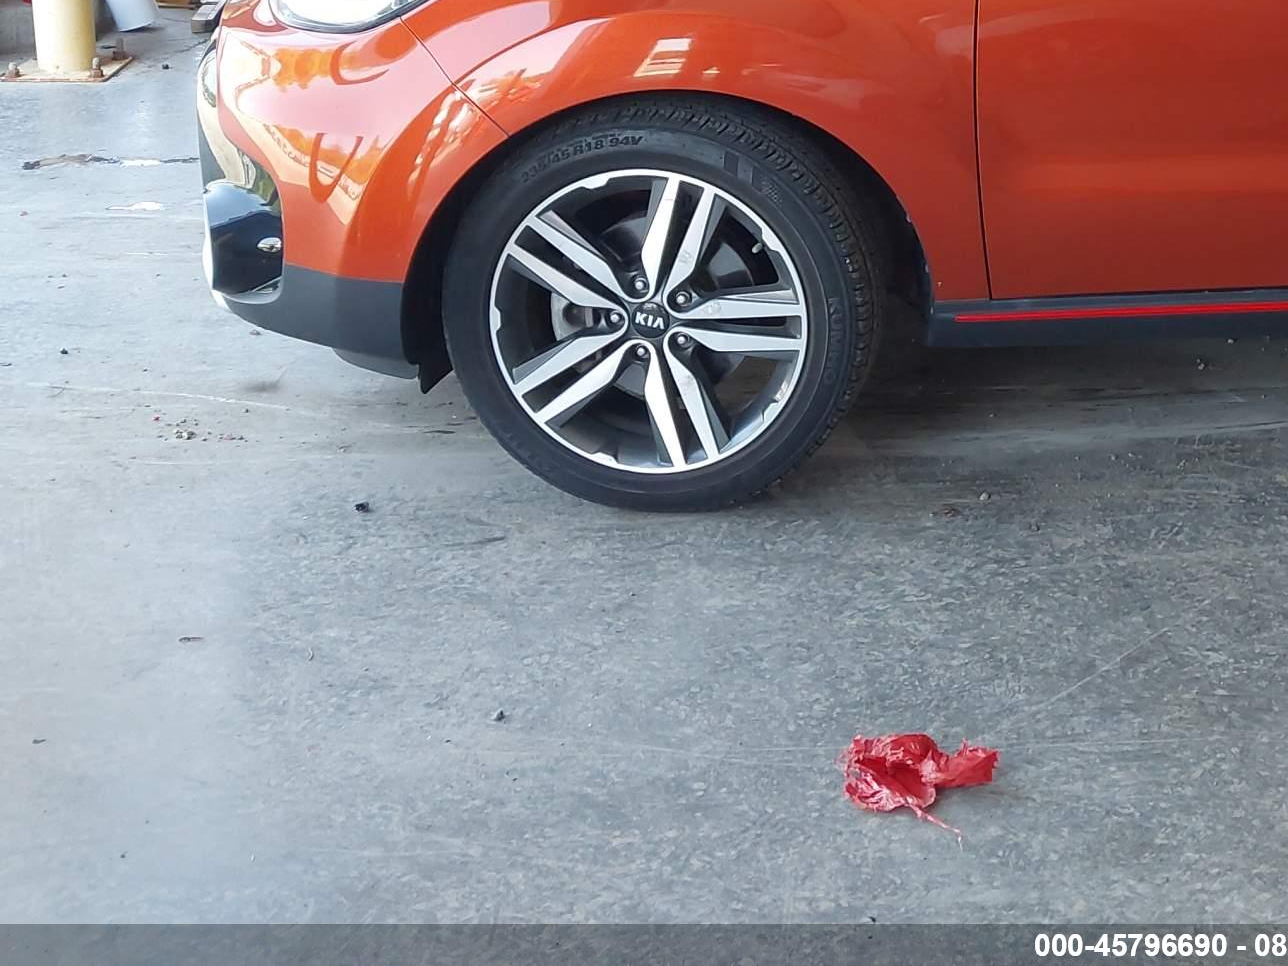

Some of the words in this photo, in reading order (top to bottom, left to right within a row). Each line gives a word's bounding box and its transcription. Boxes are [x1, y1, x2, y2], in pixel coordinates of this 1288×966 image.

[521, 148, 571, 184] 235/45
[573, 136, 605, 157] R18
[609, 135, 644, 148] 94V
[634, 311, 665, 330] KIA
